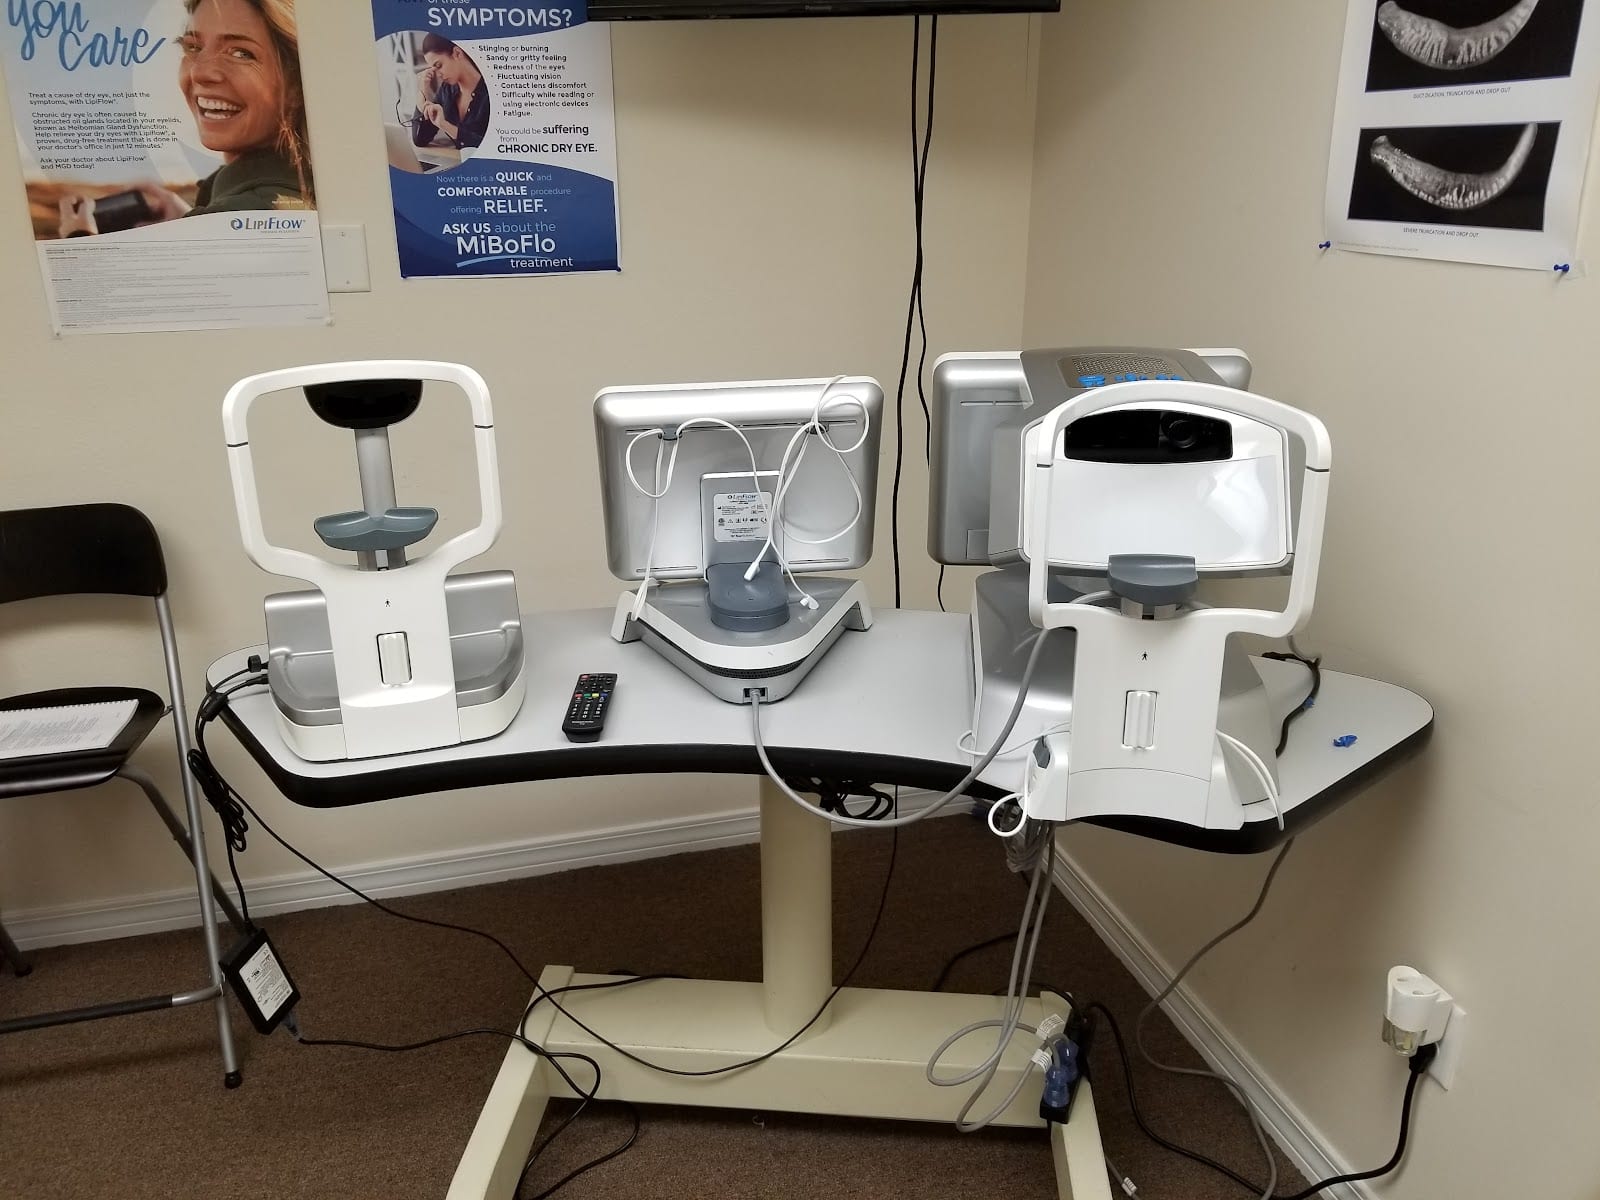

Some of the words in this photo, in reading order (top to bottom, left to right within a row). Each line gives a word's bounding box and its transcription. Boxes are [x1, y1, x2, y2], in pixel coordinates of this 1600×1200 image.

[428, 7, 572, 27] SYMPTOMS?
[8, 0, 89, 60] you
[520, 54, 540, 62] gritty
[542, 54, 567, 62] feeling
[558, 91, 584, 99] reading
[542, 124, 589, 136] suffering
[498, 144, 549, 153] CHRONIC
[552, 144, 572, 153] DRY
[576, 144, 598, 152] EYE.
[496, 172, 534, 183] QUICK
[438, 186, 527, 197] COMFORTABLE
[530, 188, 571, 196] procedure
[450, 205, 481, 214] offering
[484, 199, 547, 214] RELIEF.
[442, 223, 470, 234] ASK
[473, 223, 491, 234] US
[495, 222, 532, 233] about
[535, 221, 556, 232] the
[457, 233, 556, 255] MiBoFlo
[510, 257, 574, 268] treatment
